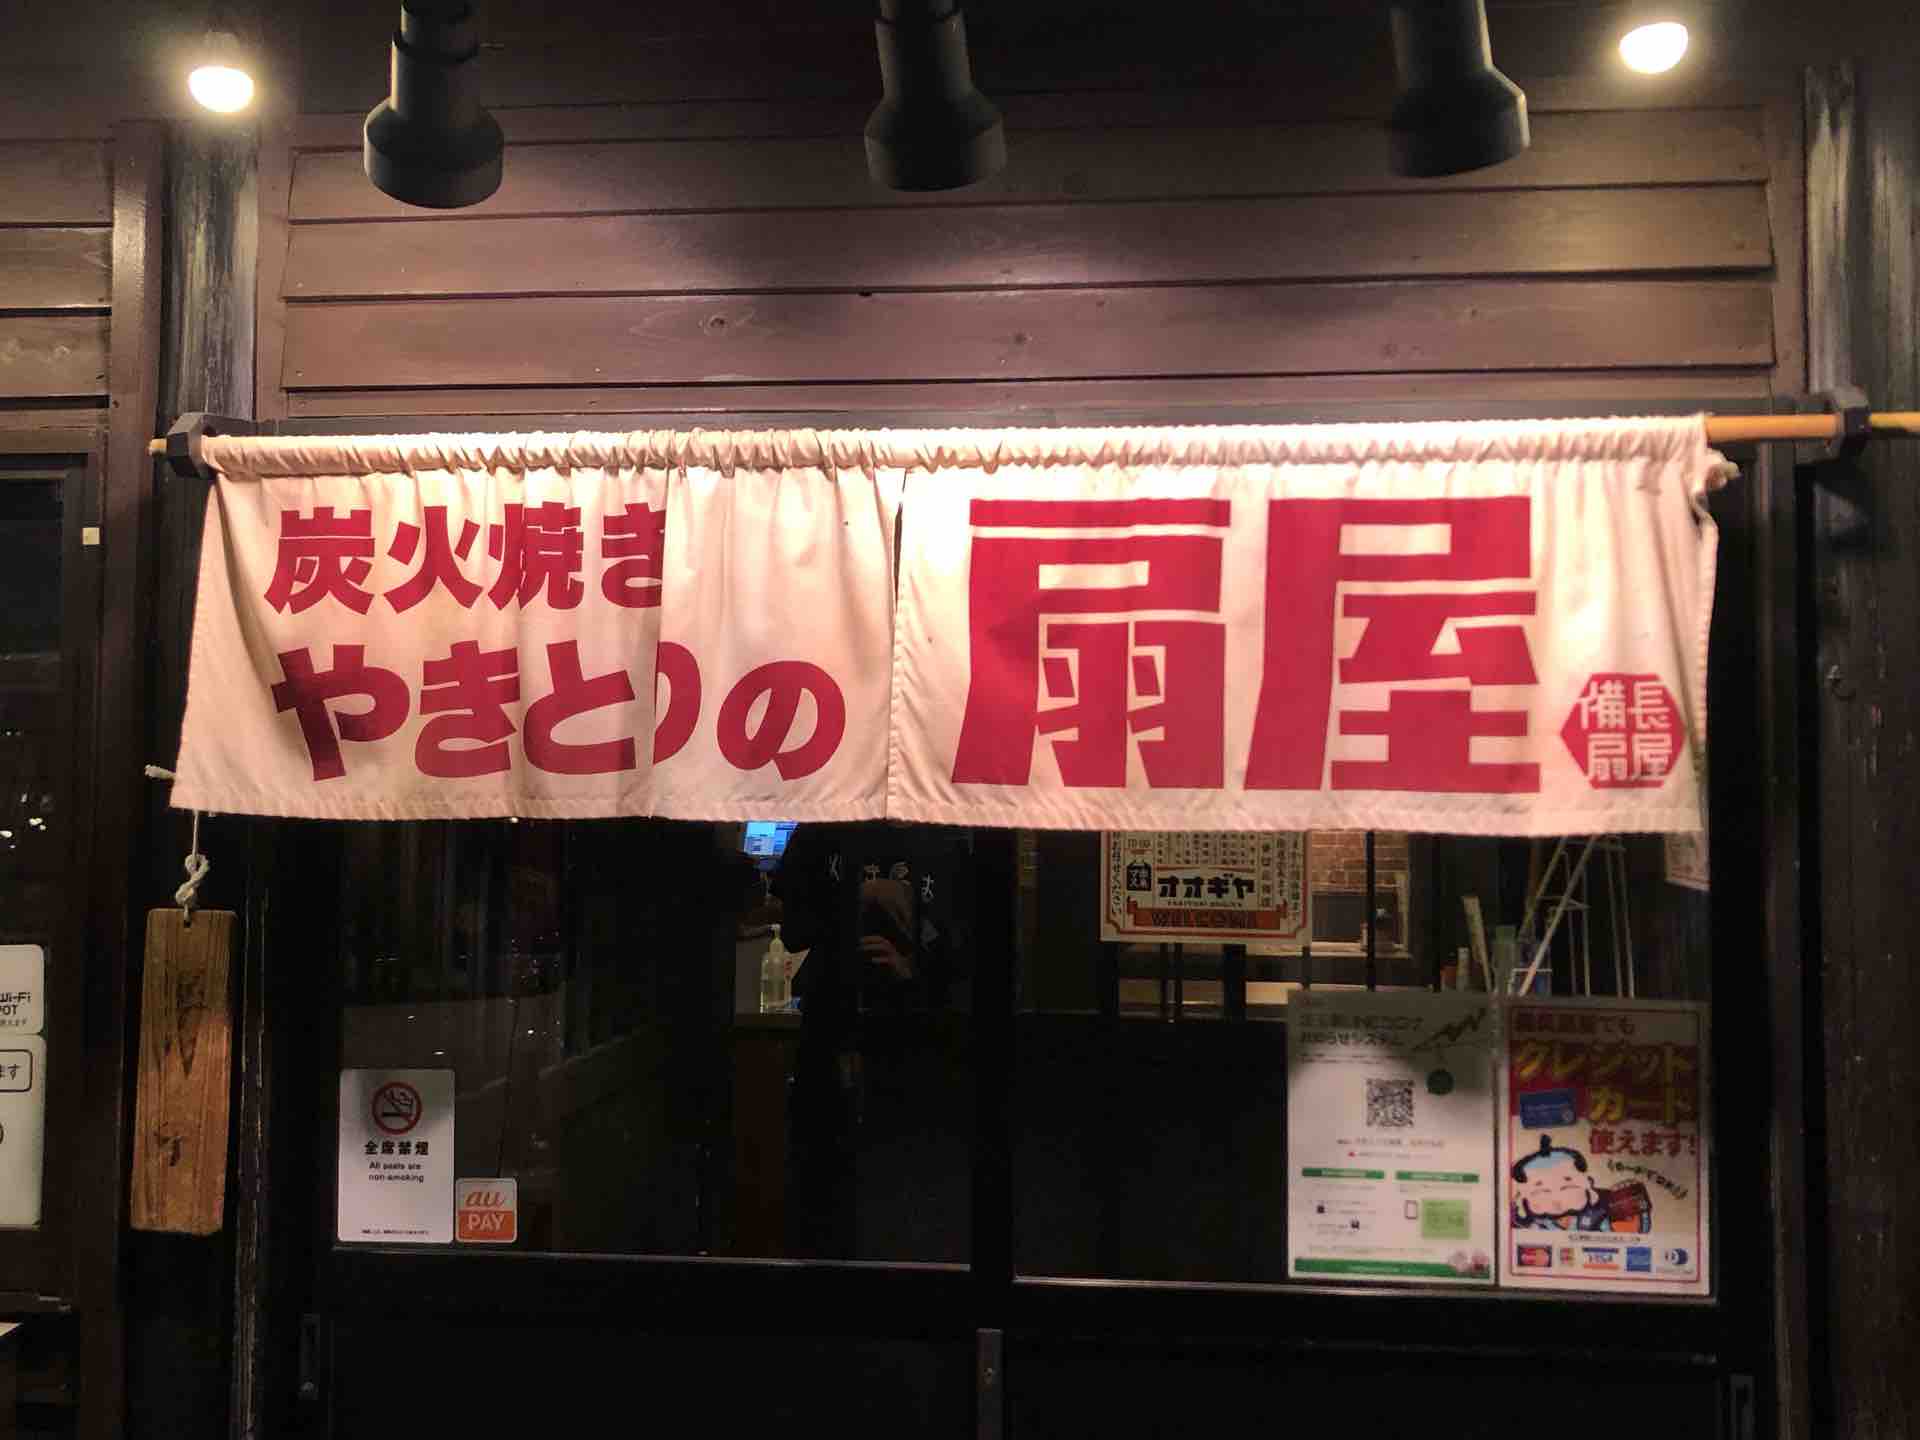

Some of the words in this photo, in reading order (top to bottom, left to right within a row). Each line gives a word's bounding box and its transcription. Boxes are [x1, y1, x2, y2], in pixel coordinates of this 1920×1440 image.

[264, 501, 666, 615] 炭火焼き
[951, 495, 1541, 793] 扇屋
[1577, 680, 1672, 730] 備長
[1588, 732, 1673, 782] 扇屋
[364, 1140, 429, 1156] 全席禁煙
[369, 1161, 381, 1171] All
[465, 1191, 505, 1208] au
[467, 1213, 506, 1232] PAY
